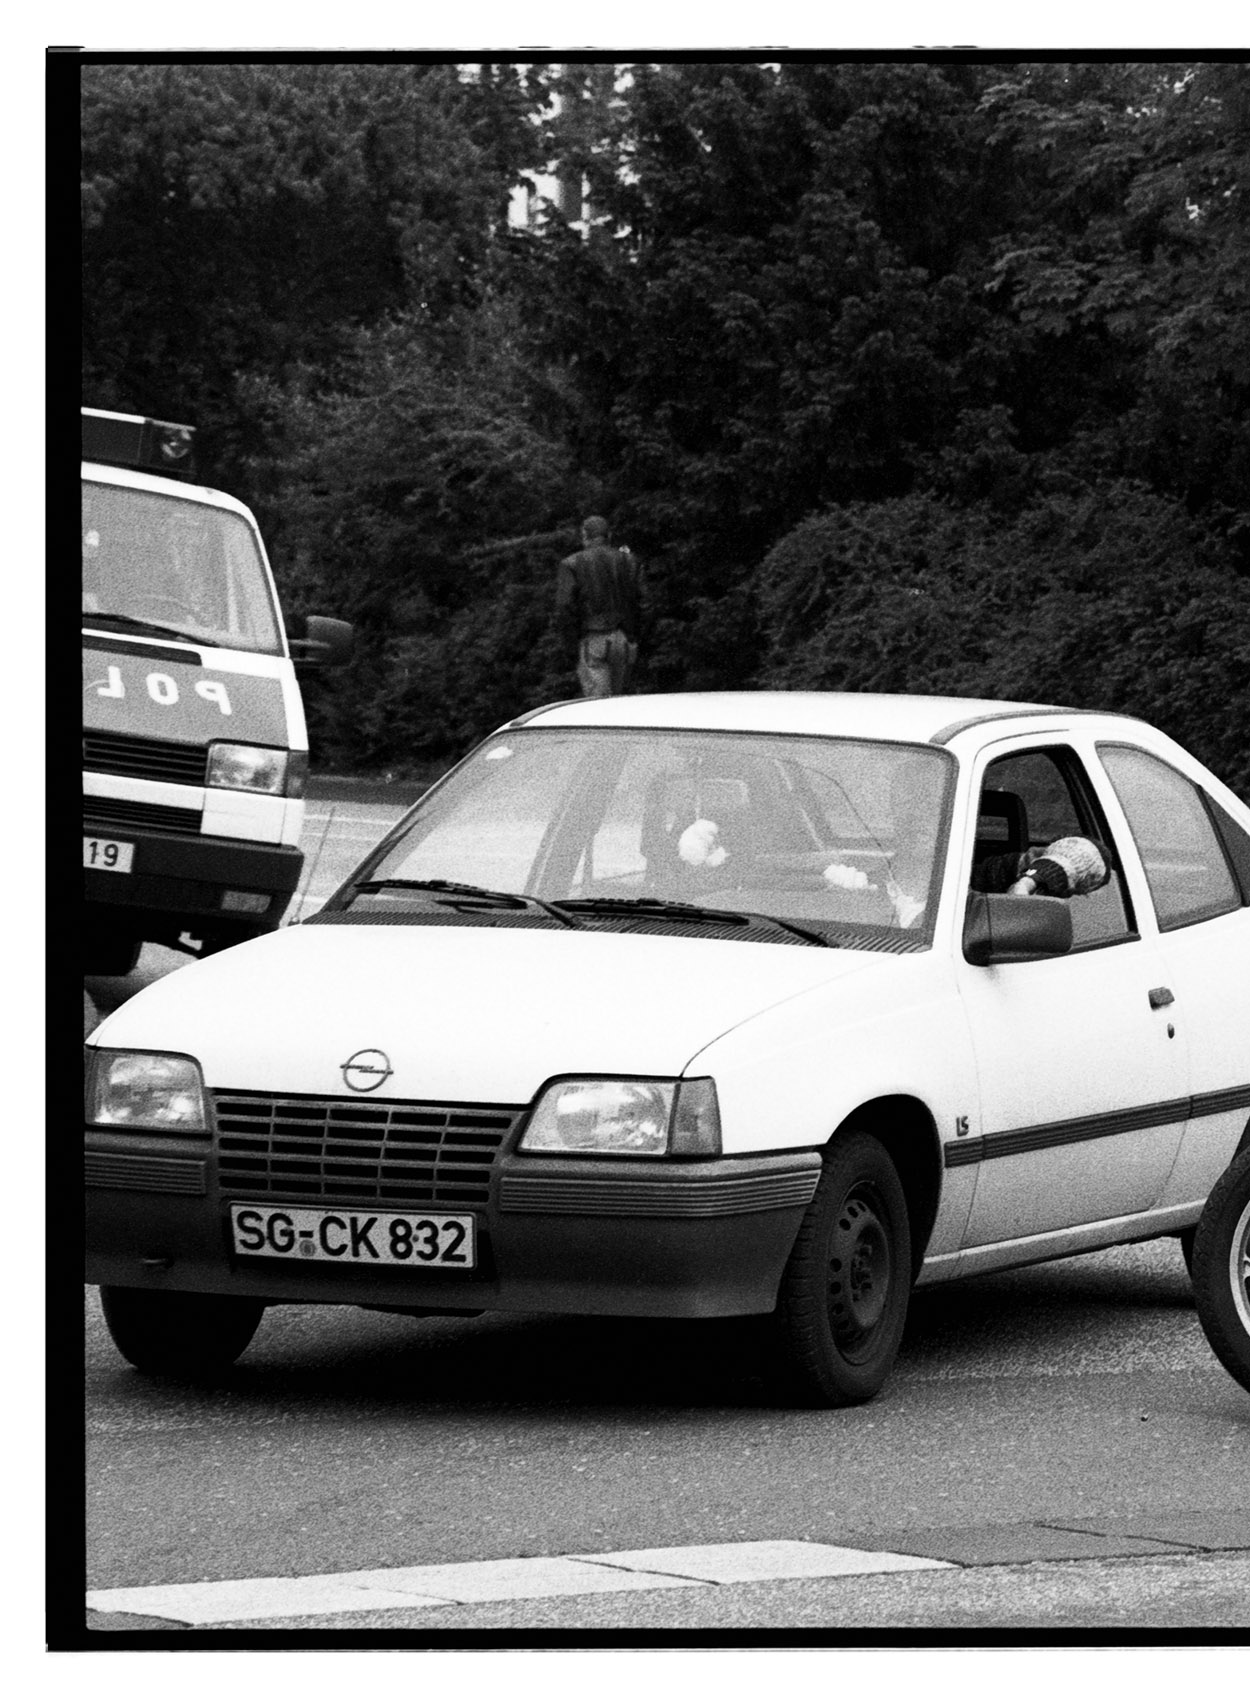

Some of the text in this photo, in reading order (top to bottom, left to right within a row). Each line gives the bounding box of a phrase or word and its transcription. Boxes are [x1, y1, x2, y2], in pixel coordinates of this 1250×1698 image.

[89, 840, 120, 867] 19
[956, 1115, 969, 1137] LS
[236, 1210, 467, 1263] SG-CK 832
